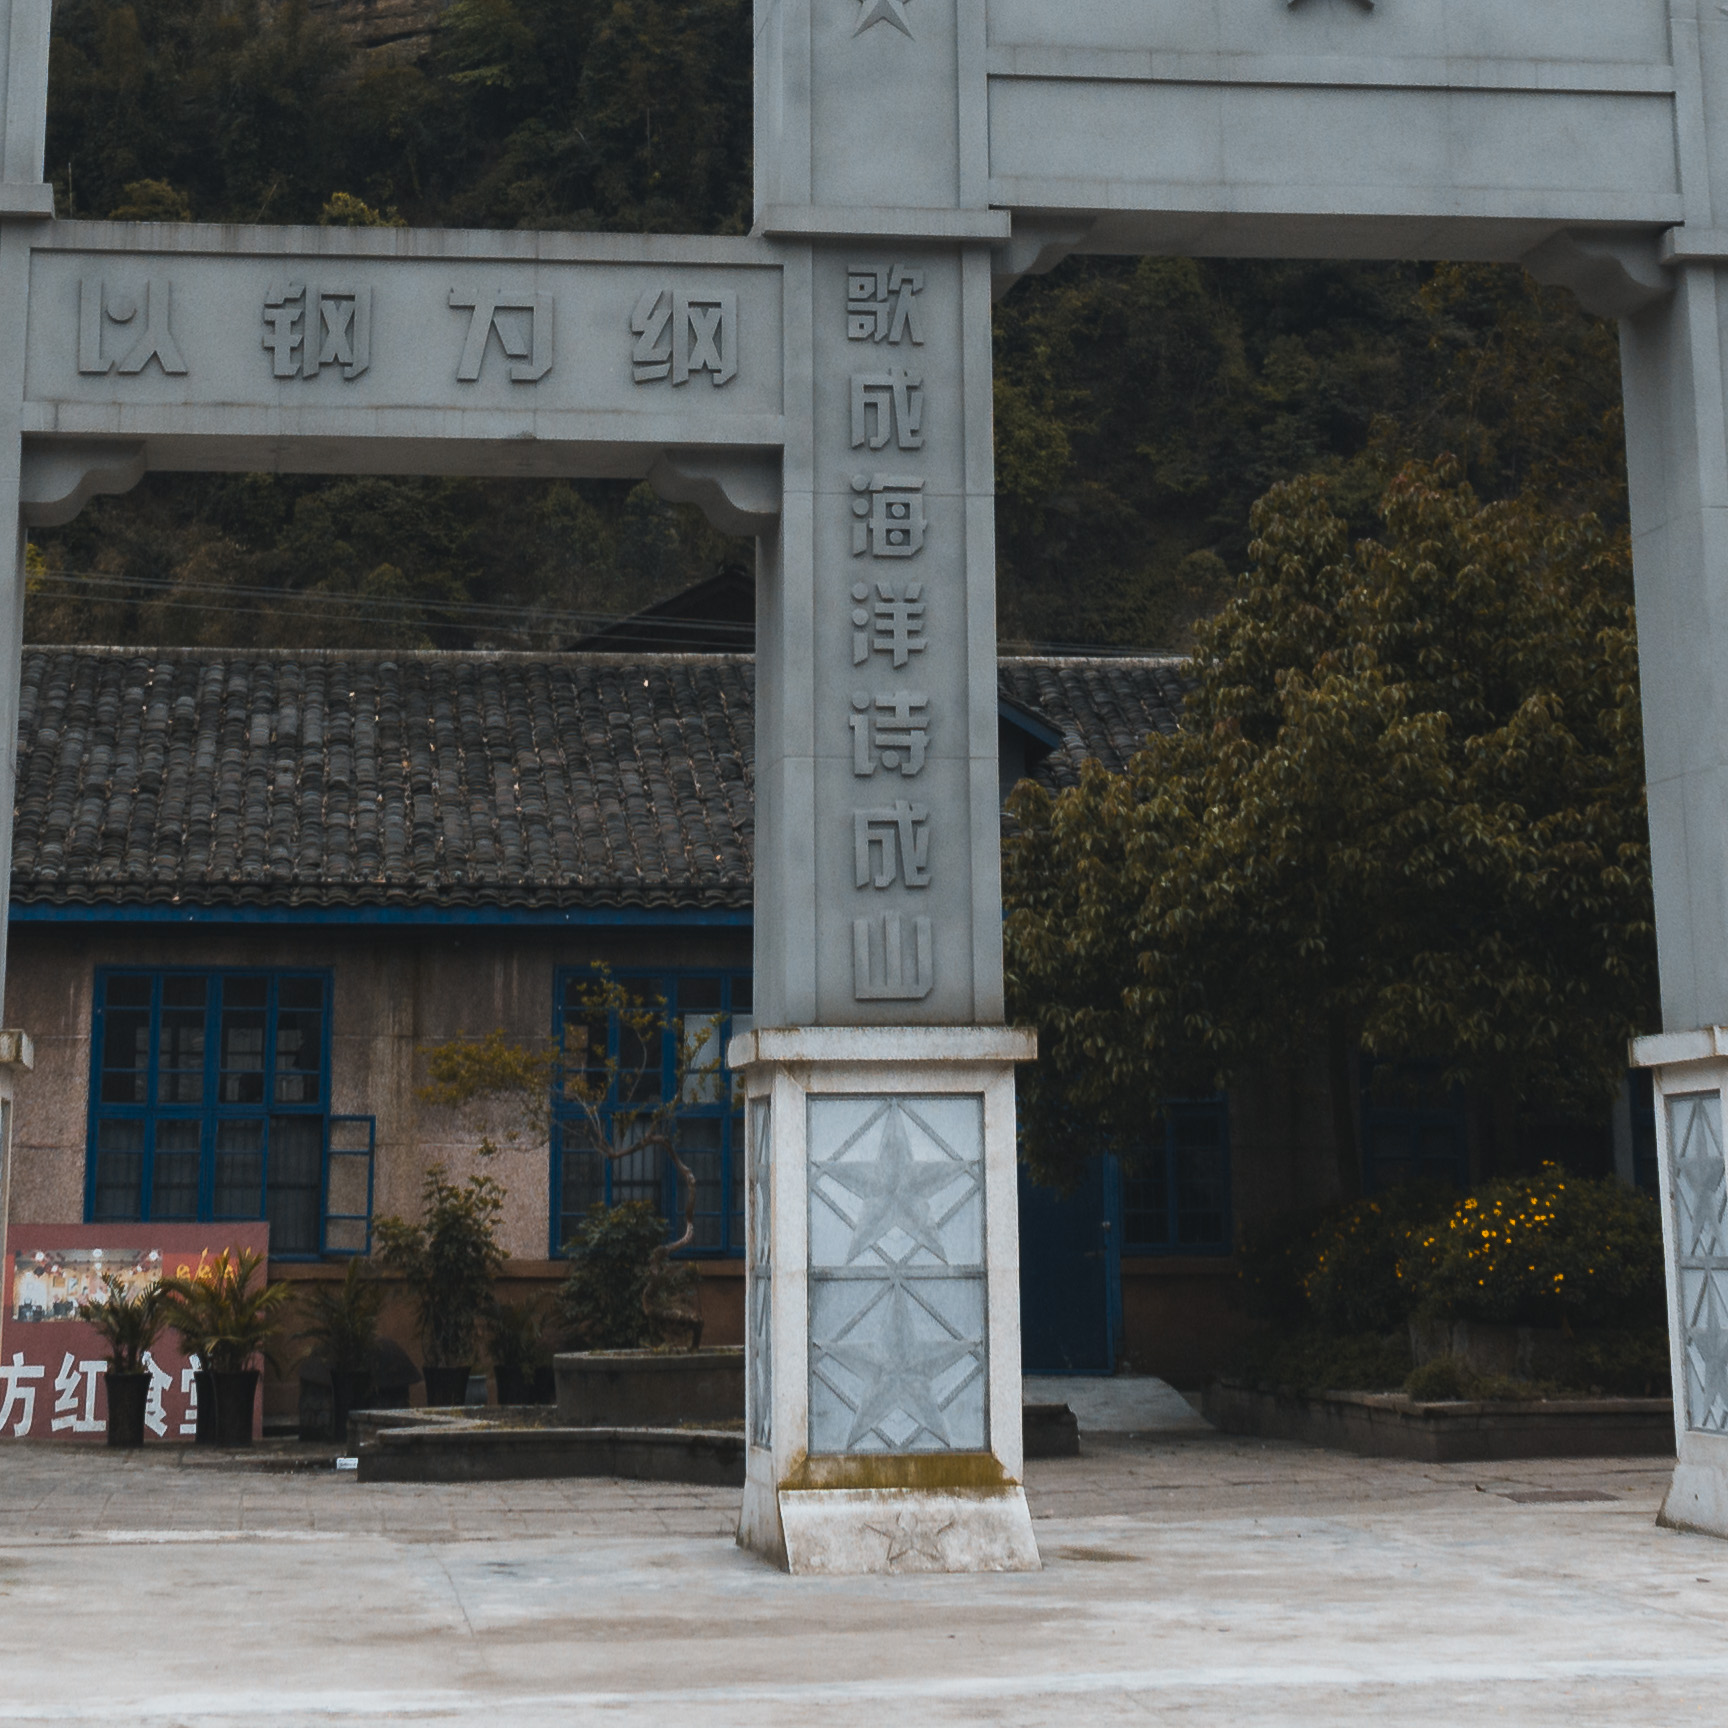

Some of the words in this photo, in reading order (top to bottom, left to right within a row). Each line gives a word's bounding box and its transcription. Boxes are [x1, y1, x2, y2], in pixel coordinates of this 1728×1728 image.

[78, 278, 739, 388] 以钢为纲
[846, 263, 935, 1001] 歌成海洋诗成山
